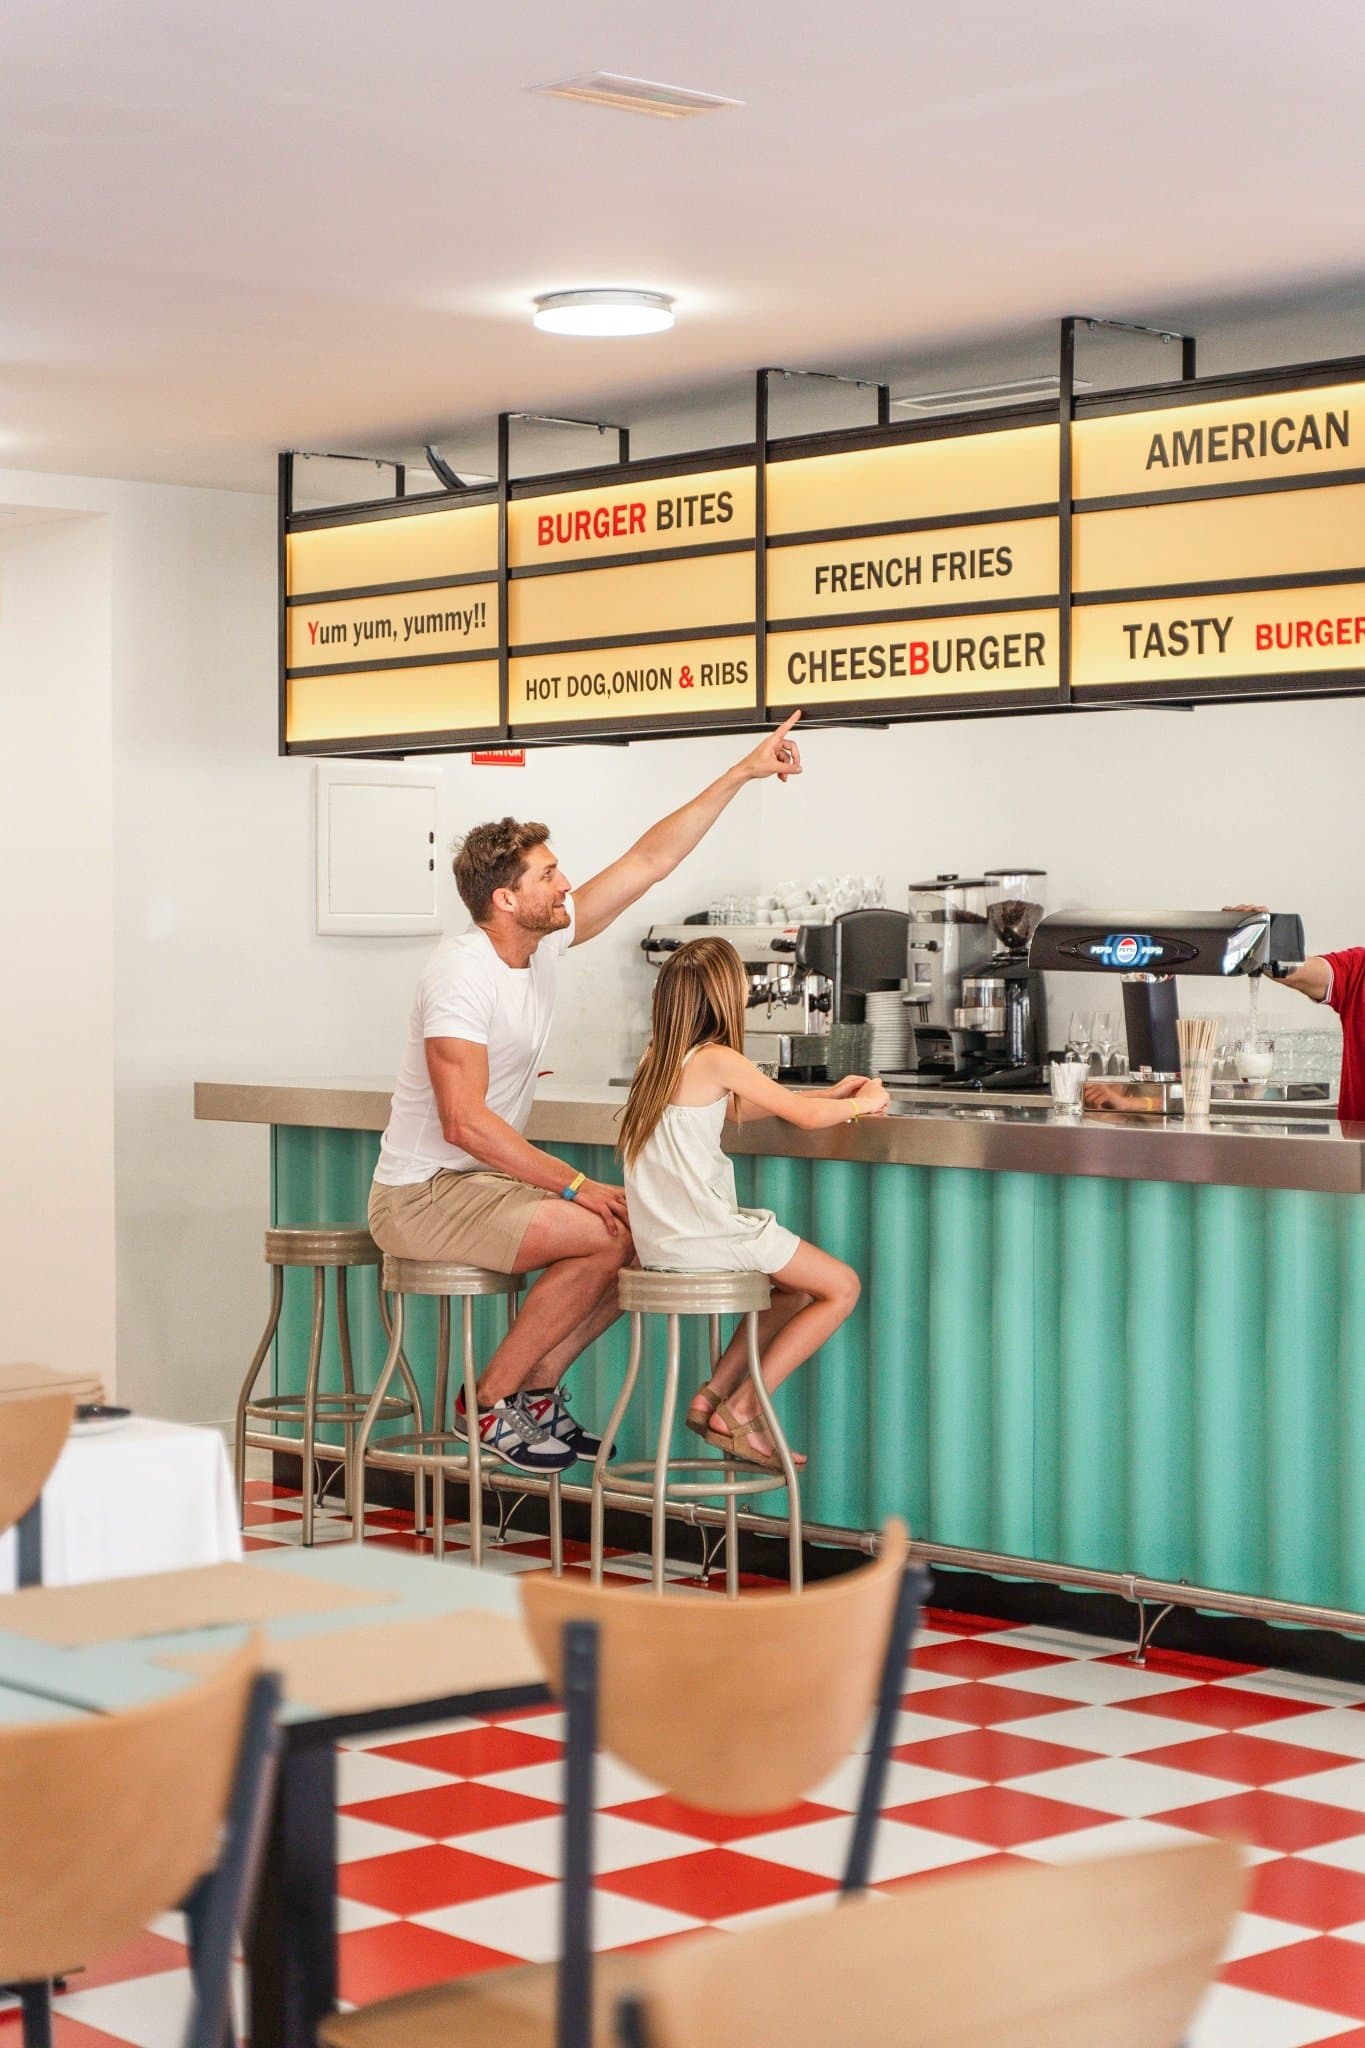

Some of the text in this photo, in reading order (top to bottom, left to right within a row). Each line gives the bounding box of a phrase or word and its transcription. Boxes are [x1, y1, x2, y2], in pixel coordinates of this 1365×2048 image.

[1145, 409, 1351, 470] AMERICAN
[537, 491, 734, 546] BURGER BITES
[815, 546, 1013, 595] FRENCH FRIES
[308, 602, 486, 647] Yum yum, yummy!!
[1122, 616, 1234, 660] TASTY
[526, 677, 562, 701] HOT
[678, 665, 695, 689] &
[700, 660, 748, 687] RIBS
[787, 631, 1046, 685] CHEESEBURGER
